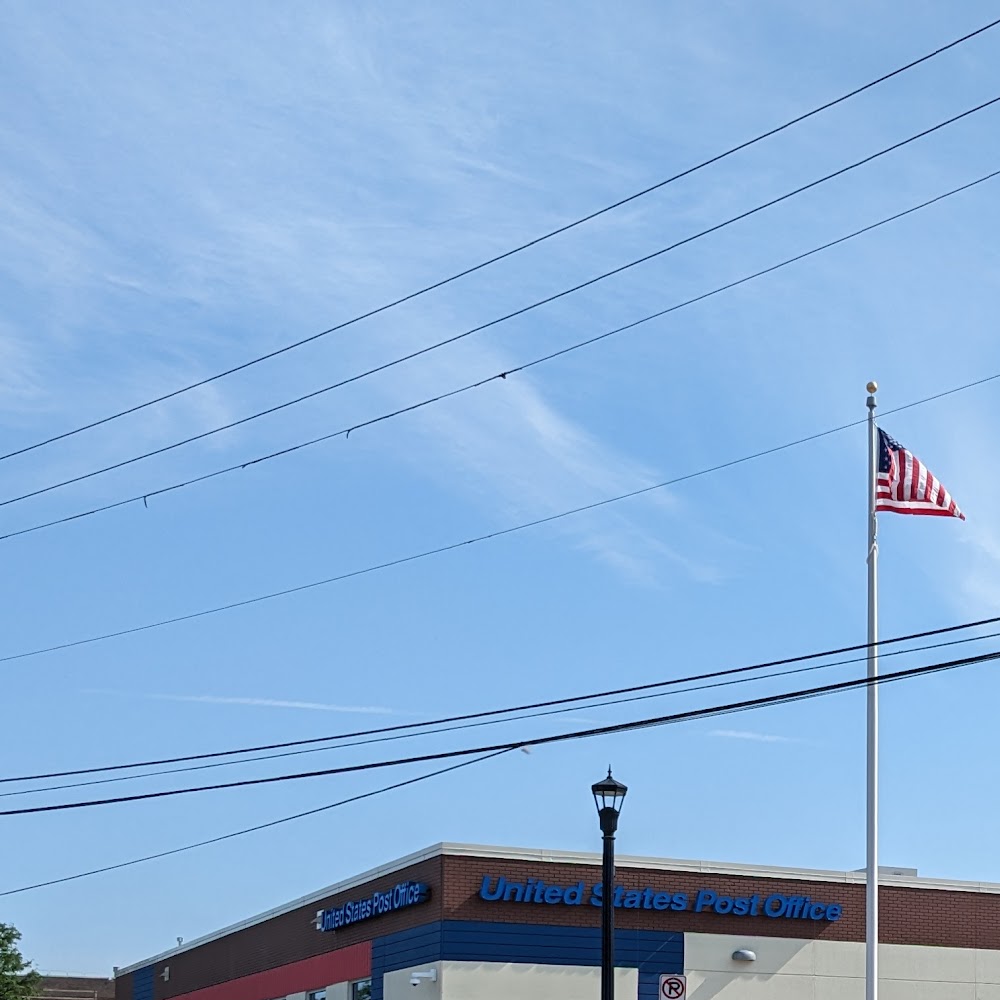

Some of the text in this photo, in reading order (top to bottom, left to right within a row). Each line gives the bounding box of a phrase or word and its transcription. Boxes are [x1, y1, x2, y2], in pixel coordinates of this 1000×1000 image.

[320, 881, 420, 932] United States Post Office
[479, 875, 842, 922] United States Post Office
